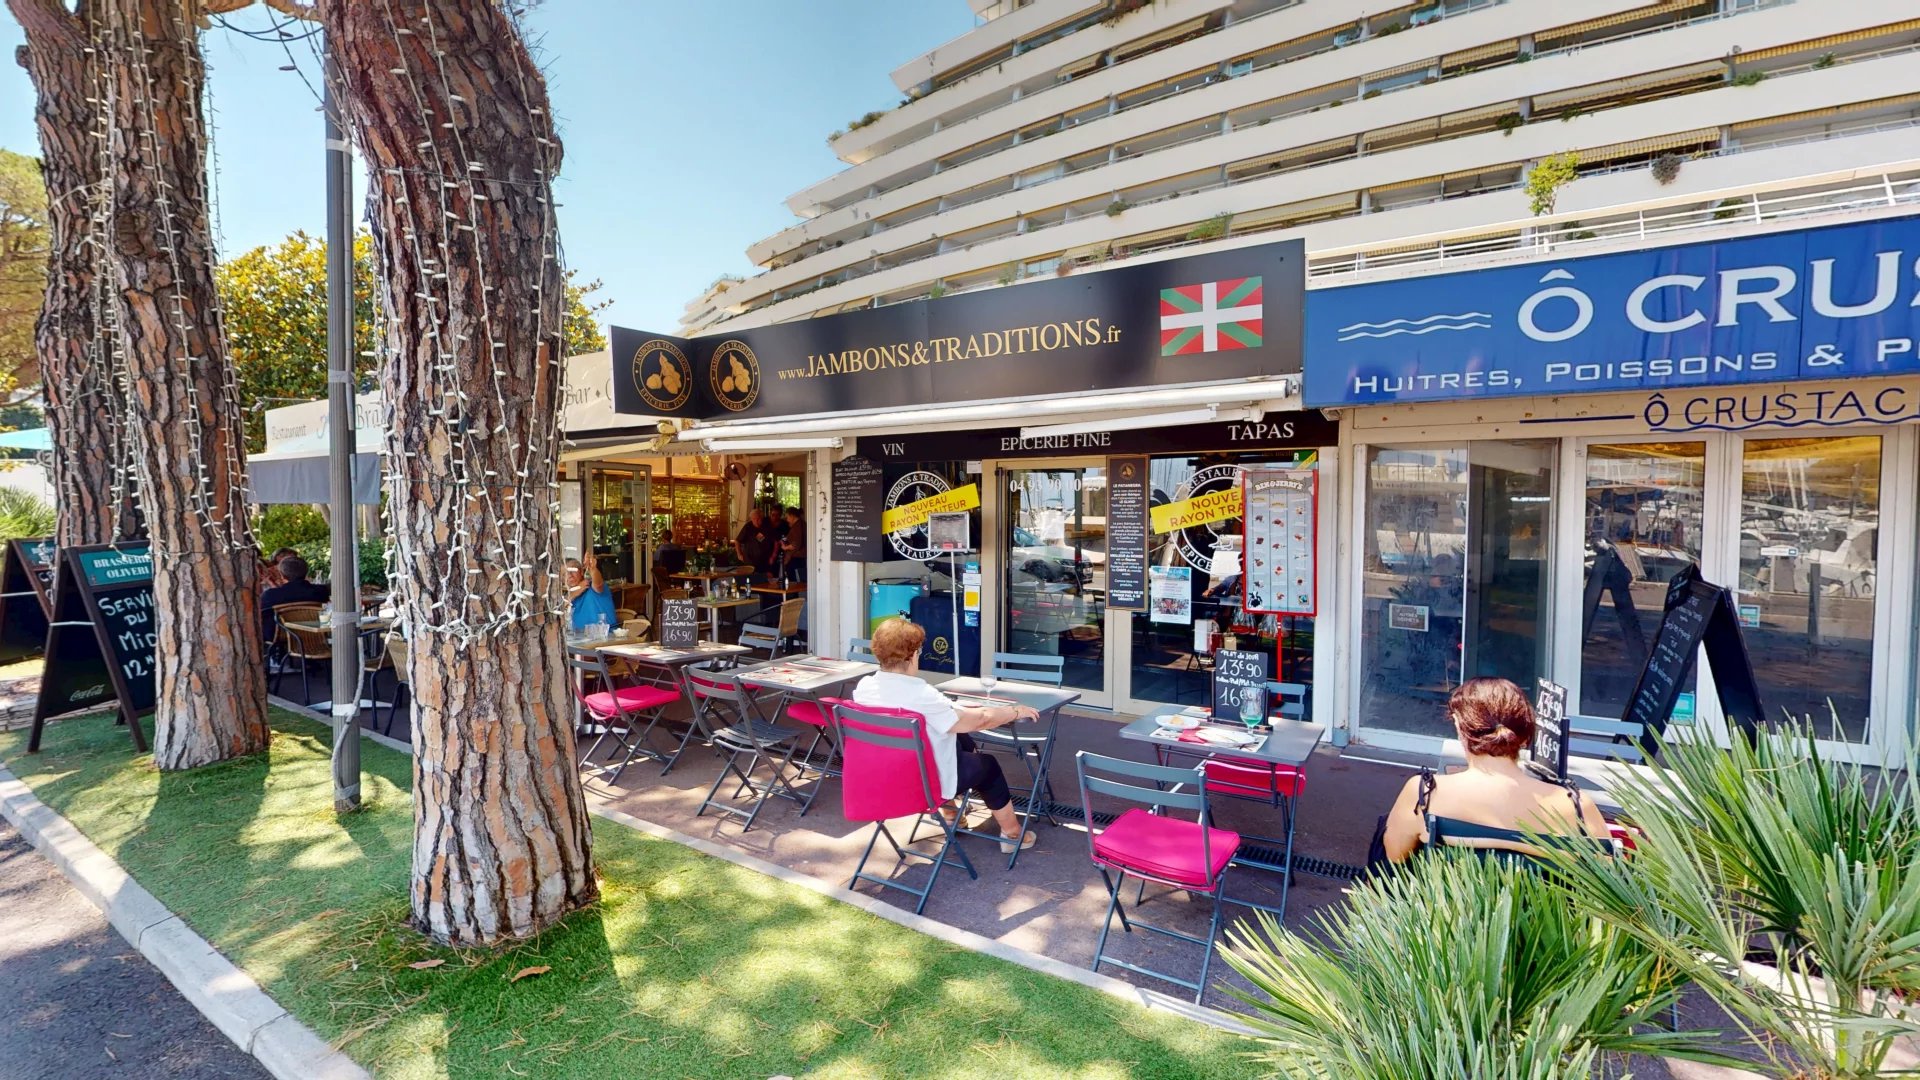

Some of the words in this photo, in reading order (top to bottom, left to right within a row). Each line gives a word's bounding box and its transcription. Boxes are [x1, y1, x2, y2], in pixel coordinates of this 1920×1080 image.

[1517, 268, 1595, 343] Ô
[1625, 251, 1920, 333] CRU
[1354, 370, 1523, 394] HUITRES,
[1545, 351, 1778, 383] POISSONS
[1807, 343, 1845, 367] &
[1877, 337, 1920, 363] P
[1644, 393, 1669, 428] Ô
[1683, 387, 1920, 426] CRUSTAC
[1073, 431, 1112, 448] FINE
[1227, 421, 1295, 441] TAPAS
[882, 442, 905, 456] VIN
[887, 476, 912, 508] JAMBONS
[1009, 479, 1025, 493] 04
[903, 495, 948, 516] NOUVEAU
[1191, 490, 1243, 511] NOUVE
[889, 514, 920, 529] RAYON
[1170, 508, 1216, 528] RAYON
[106, 565, 150, 579] OLIVERI
